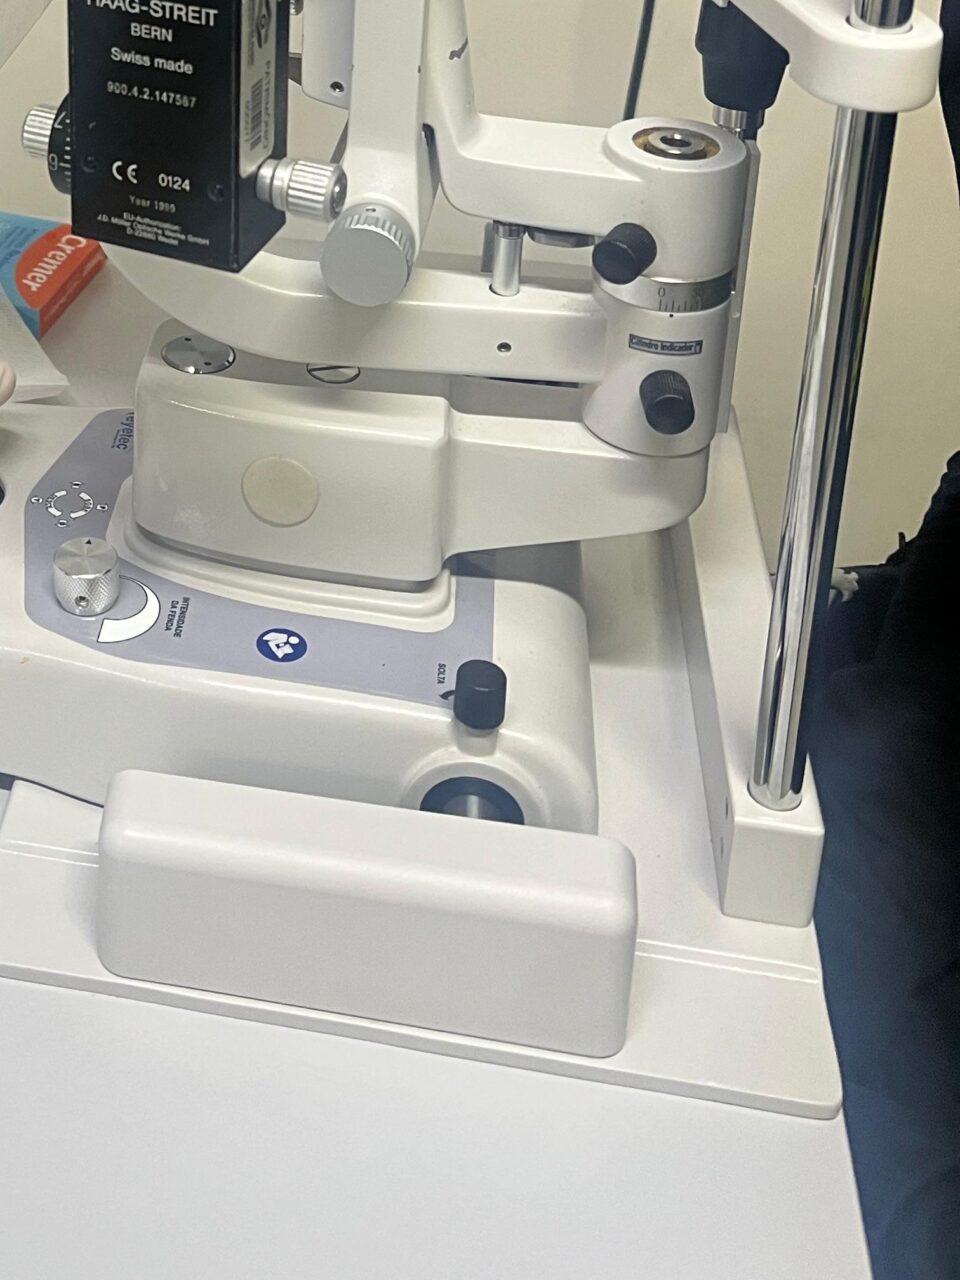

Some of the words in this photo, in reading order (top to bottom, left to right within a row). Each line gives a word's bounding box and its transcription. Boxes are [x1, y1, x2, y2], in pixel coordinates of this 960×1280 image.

[130, 22, 173, 42] BERN
[110, 47, 150, 66] Swiss
[154, 57, 193, 74] made
[158, 173, 190, 192] 0124
[22, 235, 86, 291] Cremer
[631, 336, 659, 351] Cilindro
[661, 342, 693, 352] Indicador
[164, 610, 177, 631] FENDA
[173, 596, 190, 638] INTENSIDADE
[437, 663, 446, 685] SOLTA
